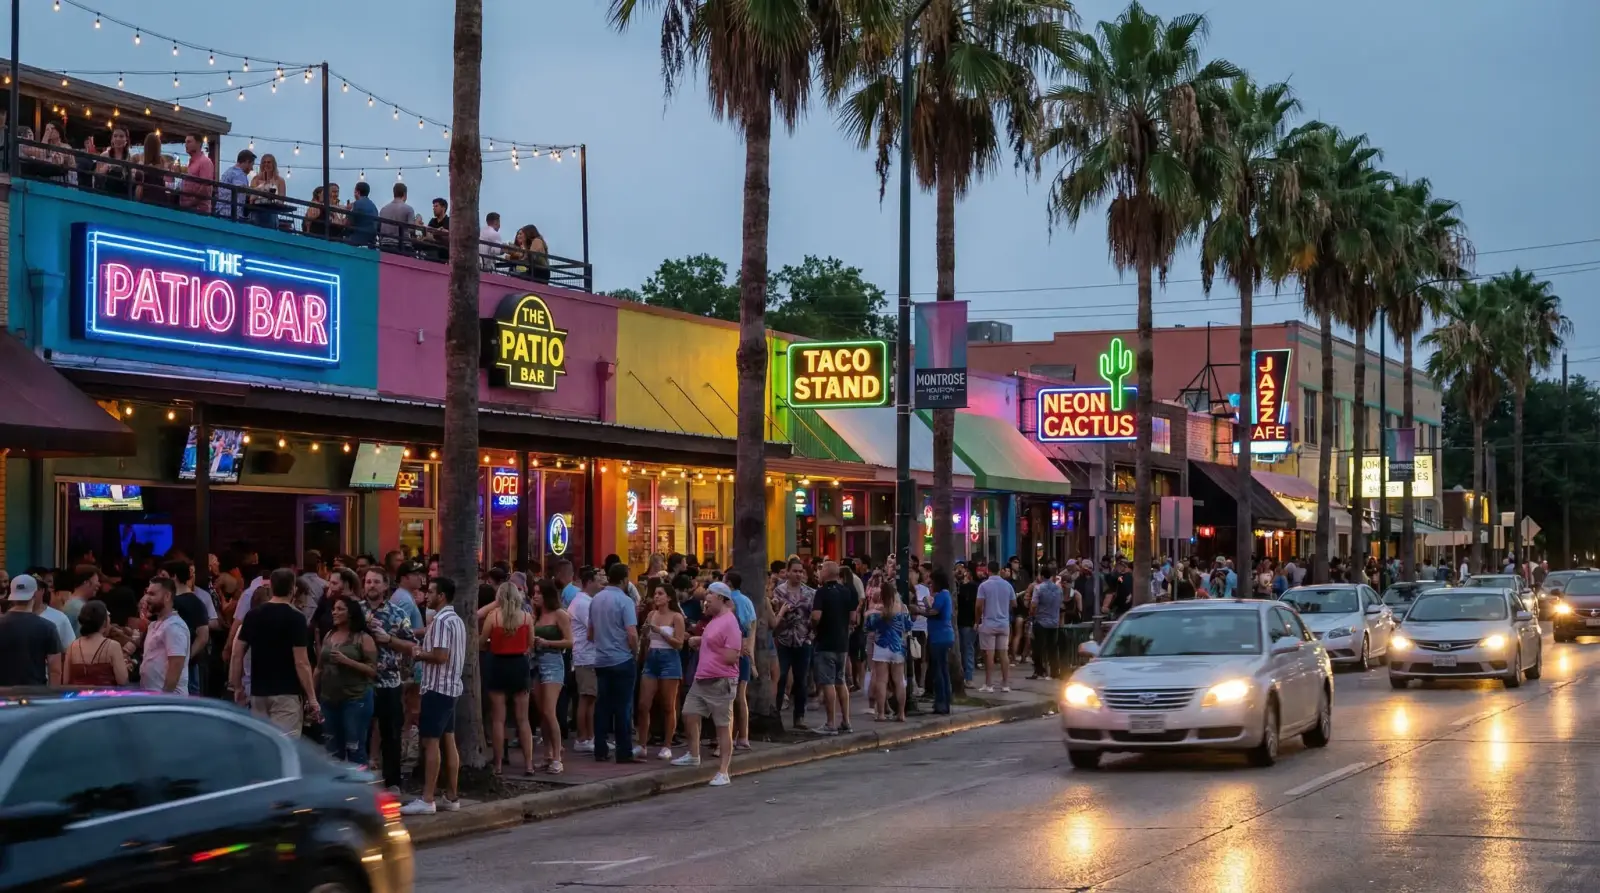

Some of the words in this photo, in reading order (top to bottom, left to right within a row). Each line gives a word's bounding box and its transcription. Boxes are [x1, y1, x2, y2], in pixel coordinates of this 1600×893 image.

[206, 249, 243, 276] THE
[105, 263, 236, 332] PATIO
[248, 286, 328, 345] BAR
[522, 307, 545, 325] THE
[501, 329, 564, 367] PATIO
[803, 348, 871, 373] TACO
[520, 367, 545, 384] BAR
[916, 372, 966, 387] MONTROSE
[794, 375, 880, 400] STAND
[1259, 356, 1276, 423] JAZZ
[1043, 392, 1106, 413] NEON
[1044, 415, 1135, 437] CACTUS
[1253, 426, 1286, 440] AFE
